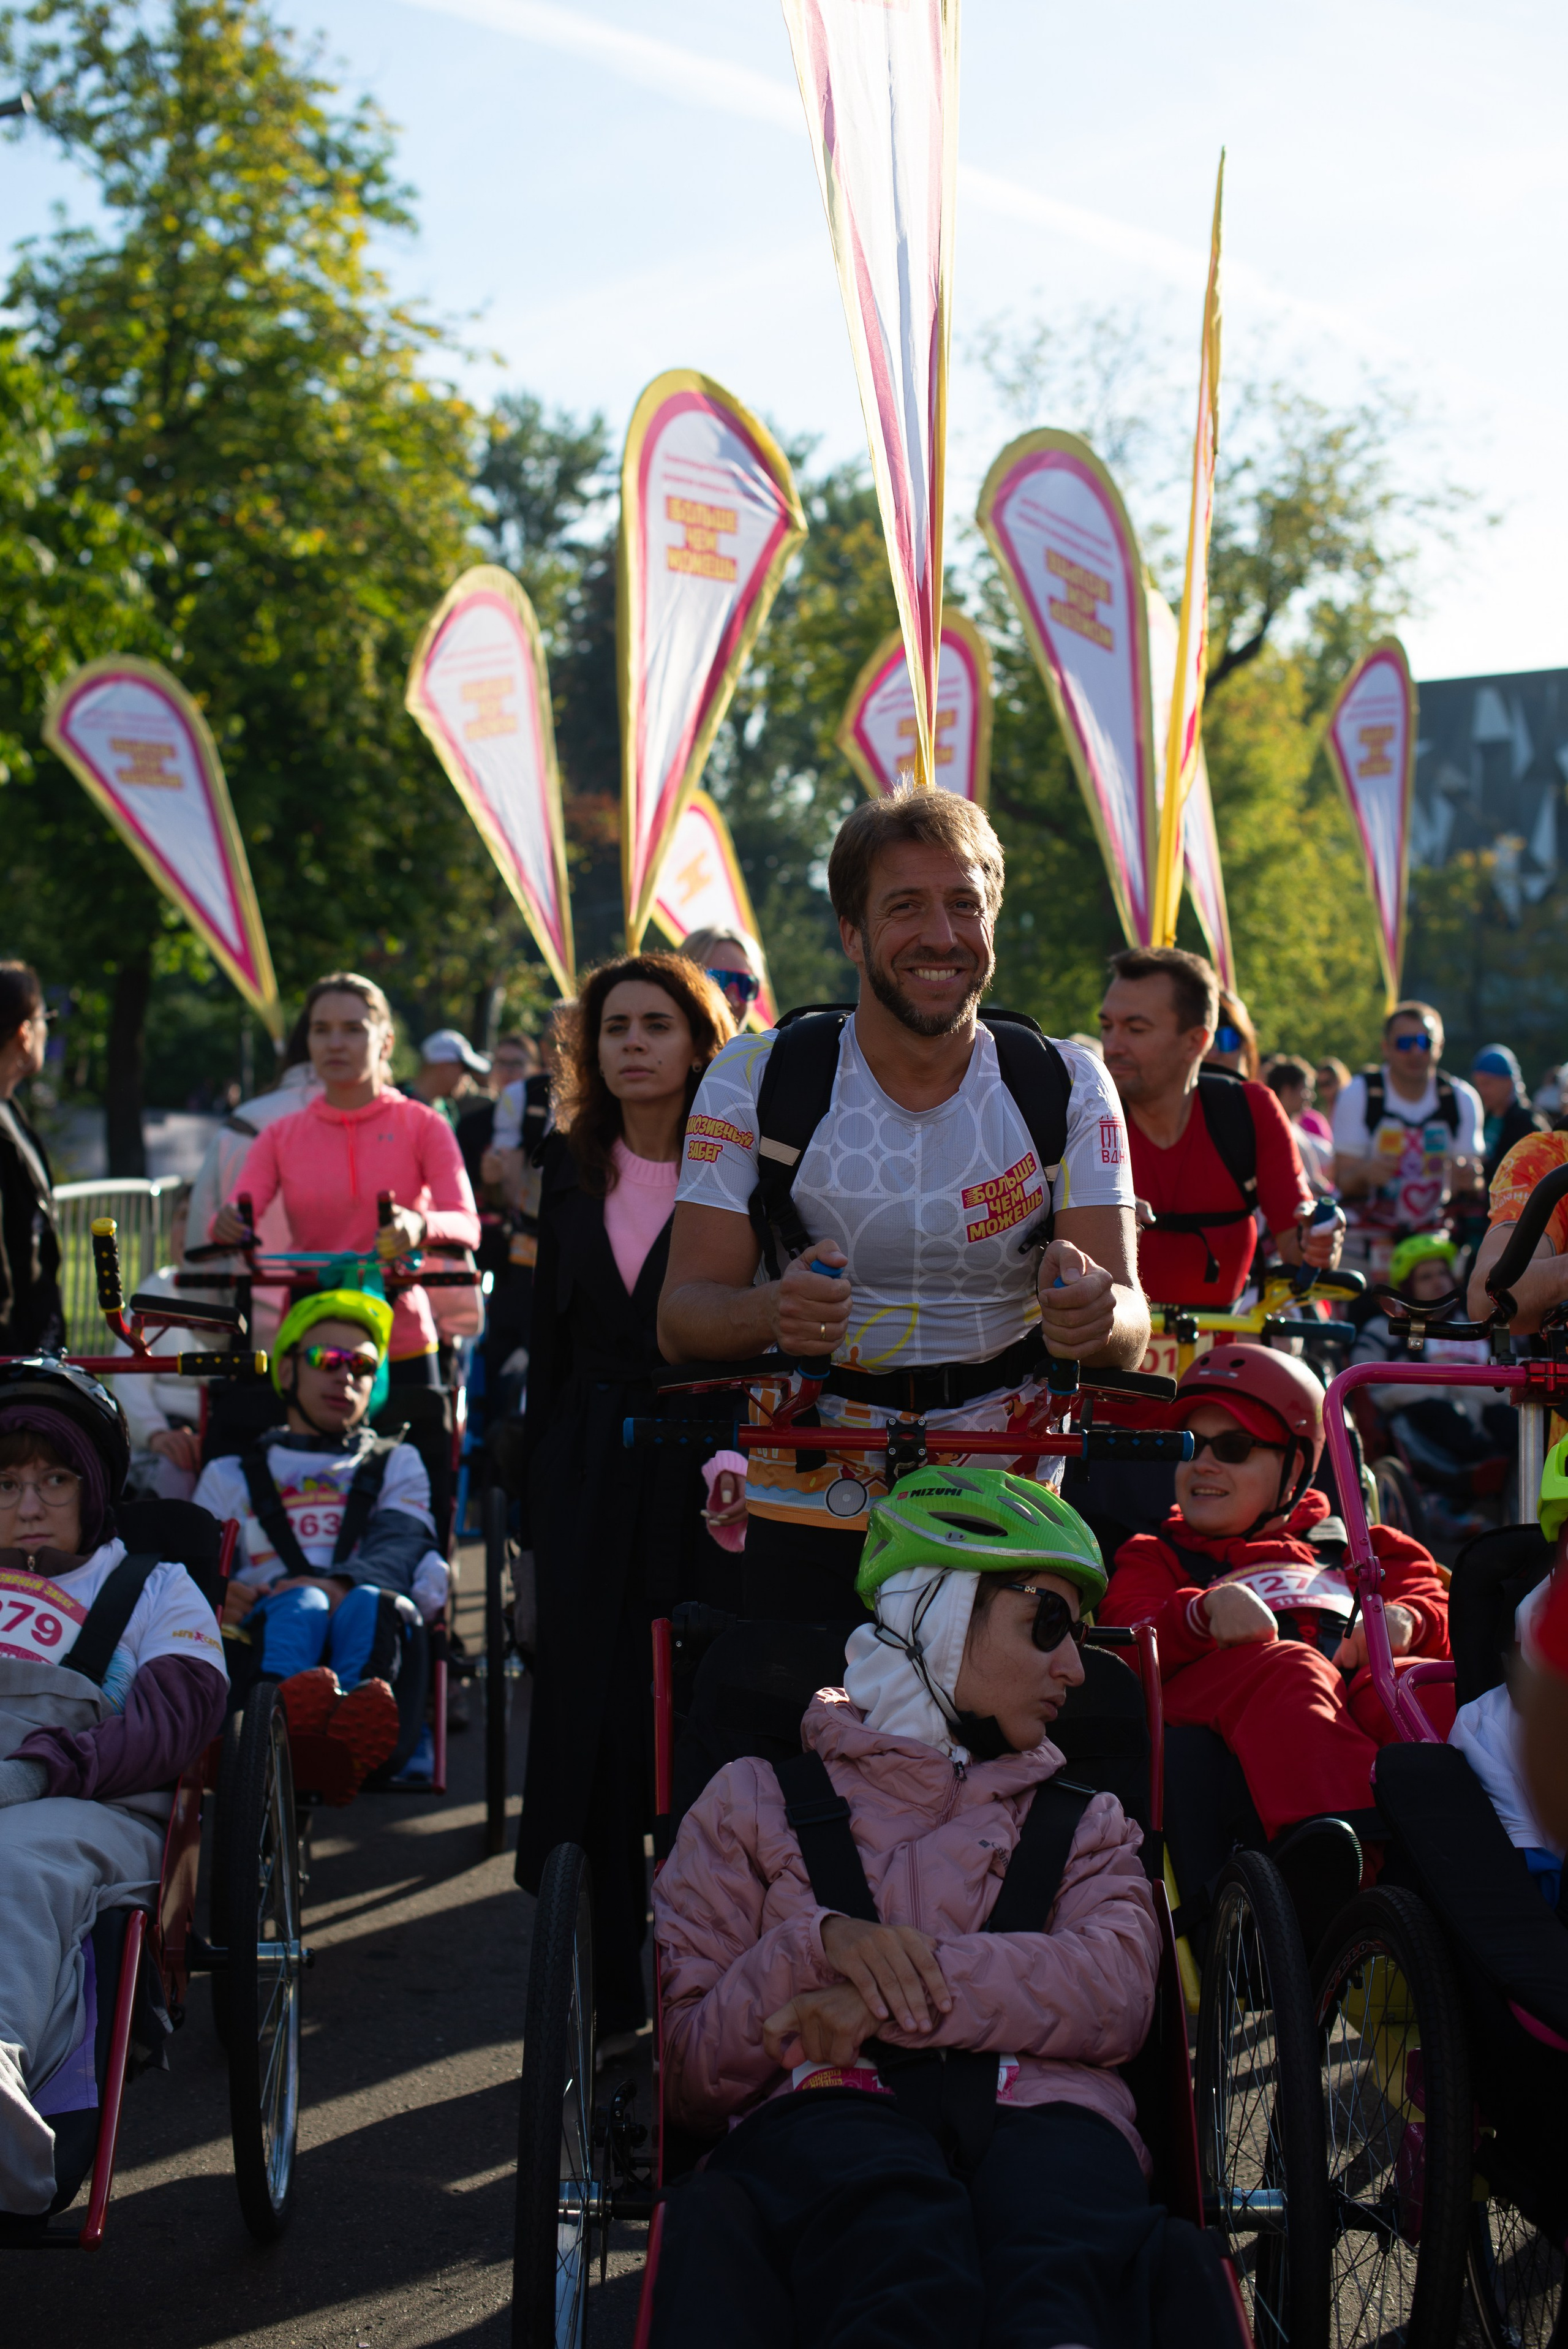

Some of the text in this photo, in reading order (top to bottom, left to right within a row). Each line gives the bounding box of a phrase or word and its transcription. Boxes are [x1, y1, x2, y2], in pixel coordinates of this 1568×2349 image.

[685, 1115, 754, 1149] ЛЮЗИВНЫЙ
[688, 1141, 722, 1162] ЗАБЕГ
[965, 1155, 1035, 1207] БОЛЬШЕ
[989, 1185, 1024, 1214] ЧЕМ
[970, 1191, 1042, 1241] МОЖЕШЬ
[910, 1488, 963, 1498] MIZUMI
[288, 1511, 341, 1537] 63
[0, 1600, 63, 1647] 79
